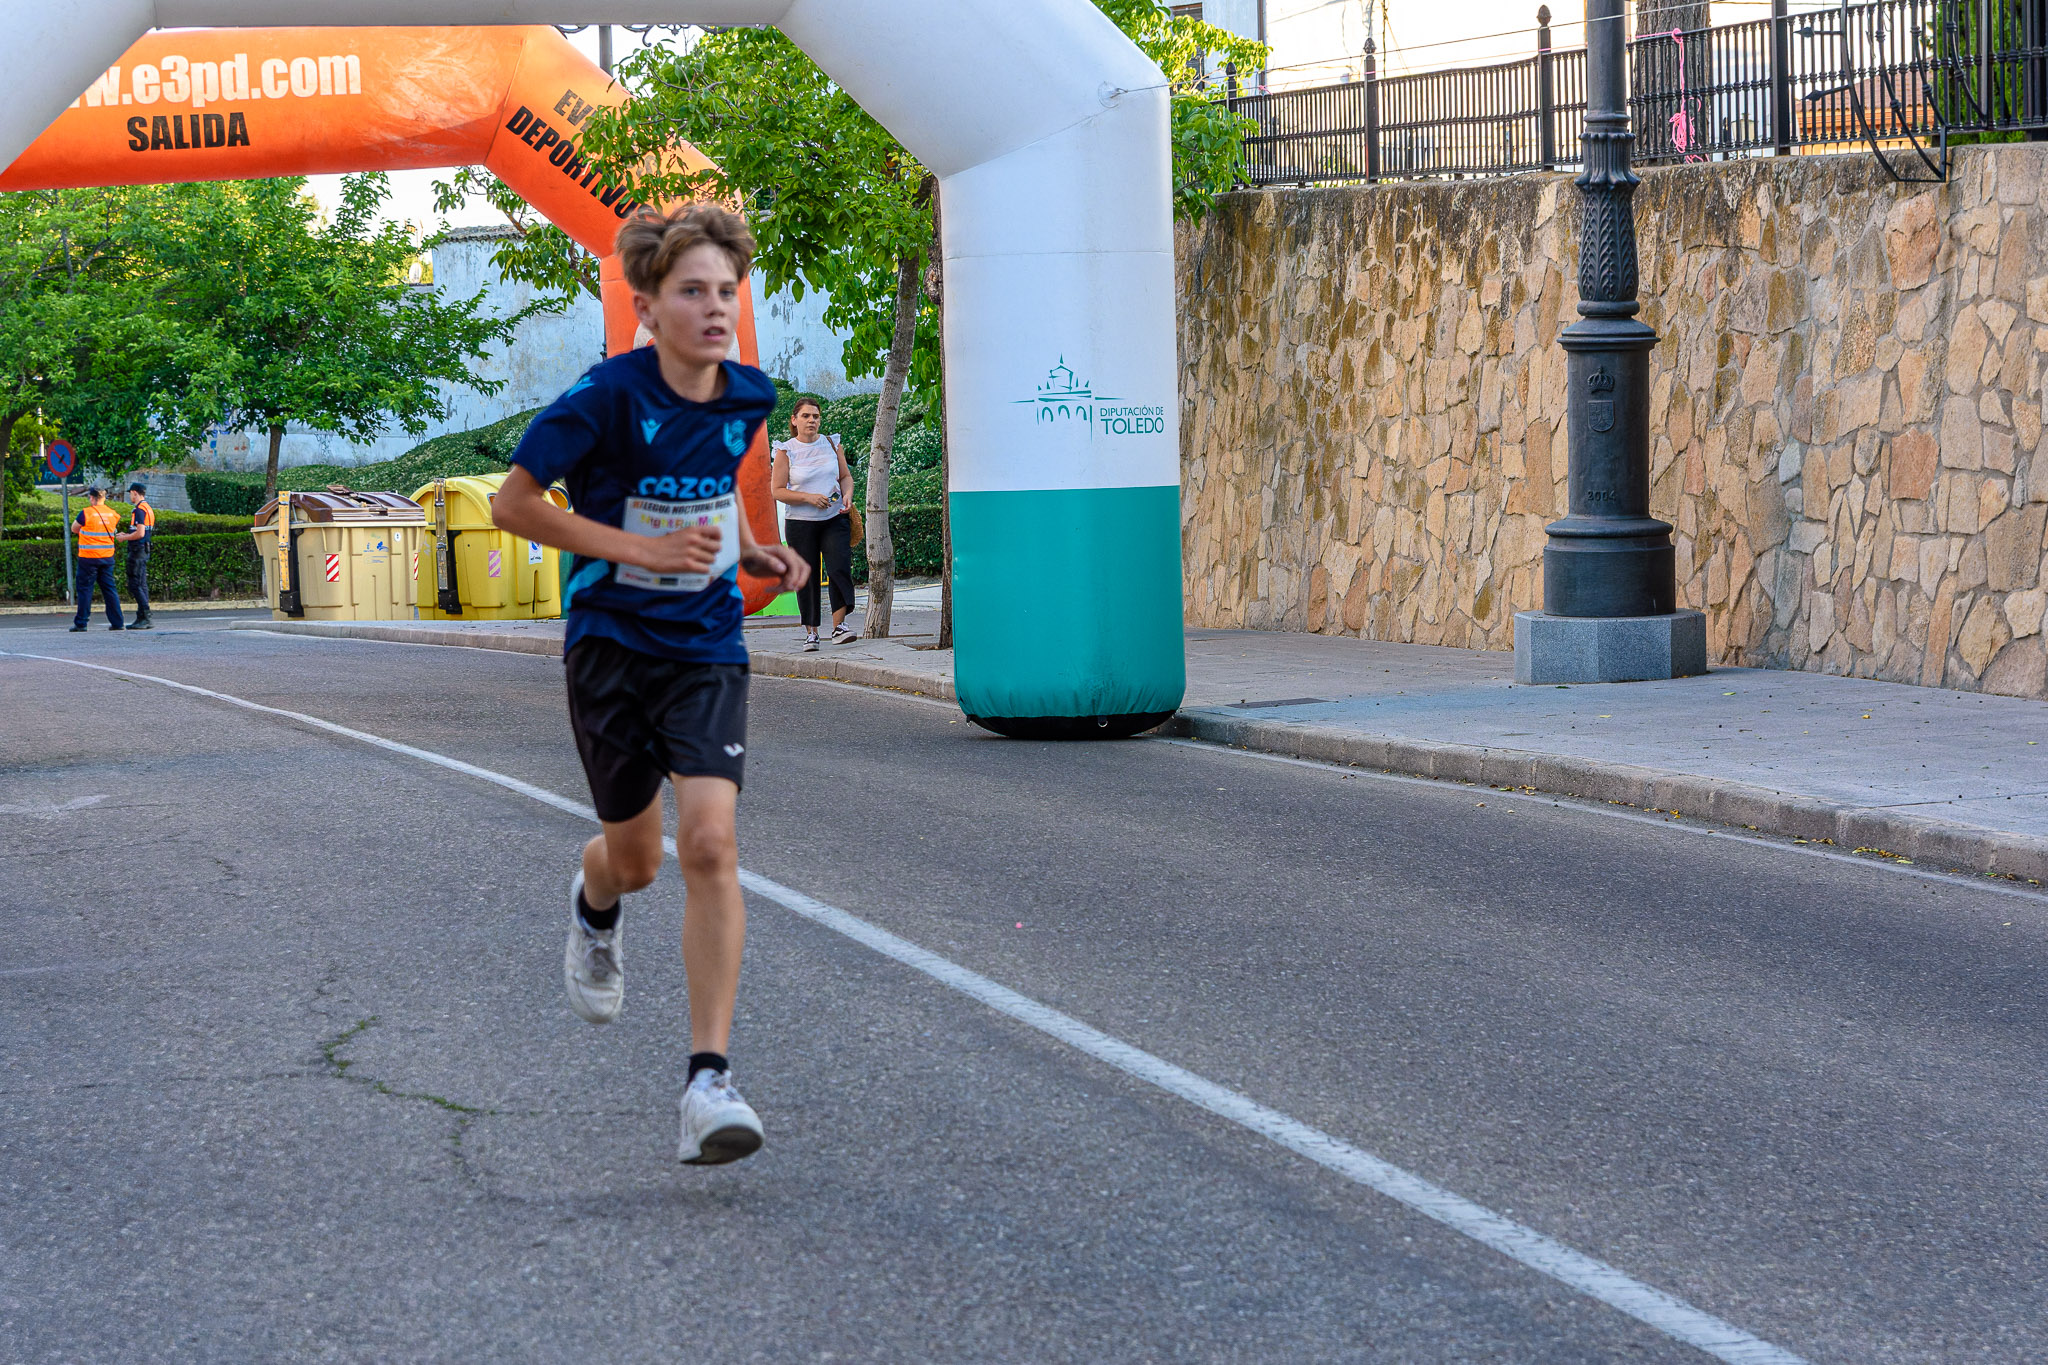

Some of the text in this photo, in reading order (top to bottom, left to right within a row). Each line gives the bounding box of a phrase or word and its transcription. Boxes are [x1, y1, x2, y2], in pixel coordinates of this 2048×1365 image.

[69, 53, 362, 109] w.e3pd.com
[127, 111, 251, 152] SALIDA
[1100, 404, 1164, 417] DIPUTACIÓN DE
[1100, 417, 1165, 435] TOLEDO
[638, 475, 732, 499] CAZOO
